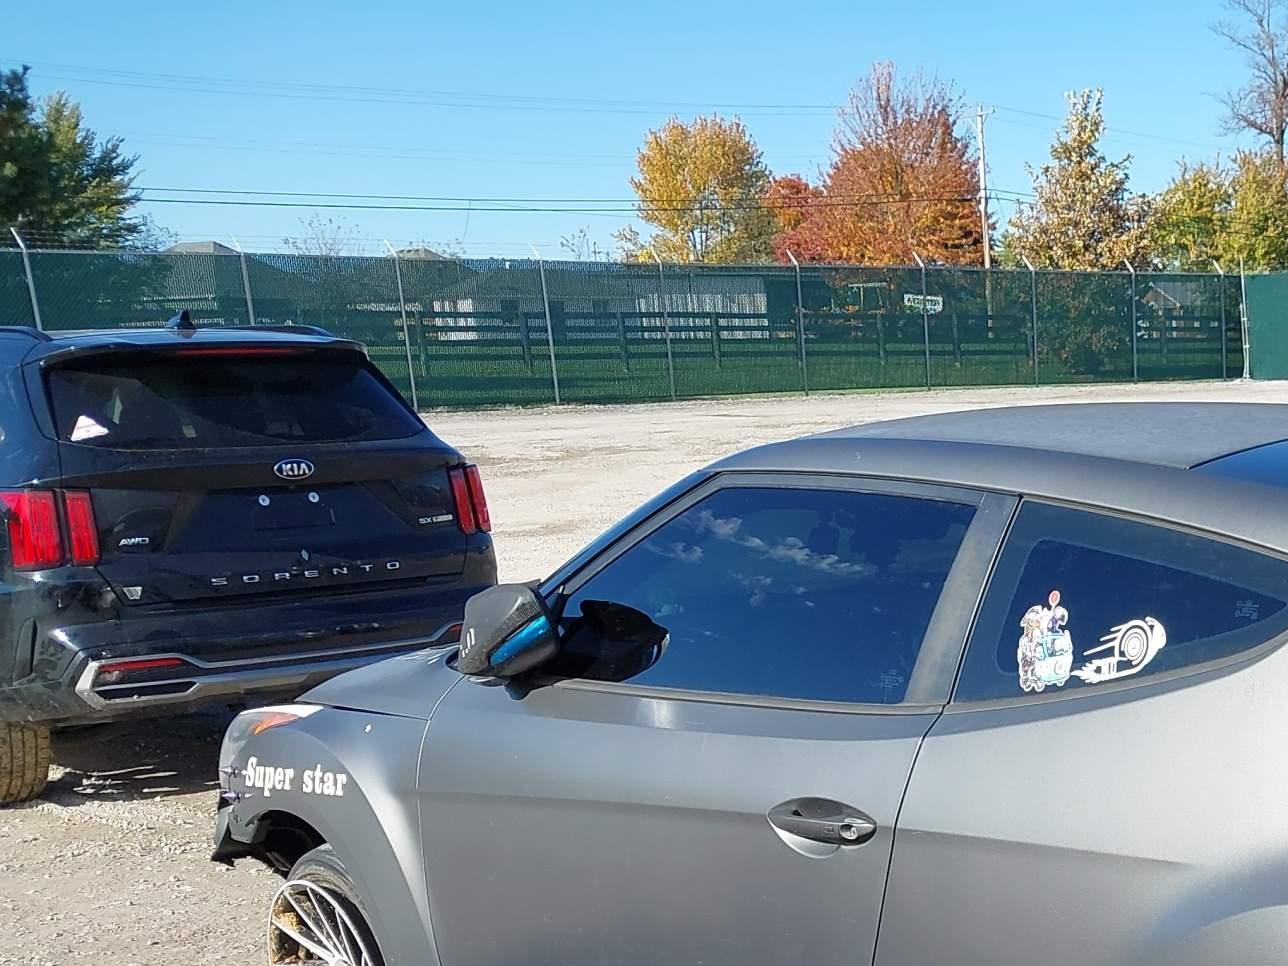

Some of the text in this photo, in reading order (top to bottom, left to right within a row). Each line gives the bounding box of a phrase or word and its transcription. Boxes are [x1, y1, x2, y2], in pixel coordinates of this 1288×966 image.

[281, 463, 309, 476] KIA
[118, 537, 150, 546] AWD
[211, 560, 400, 586] SORENTO
[243, 756, 347, 797] Super star
